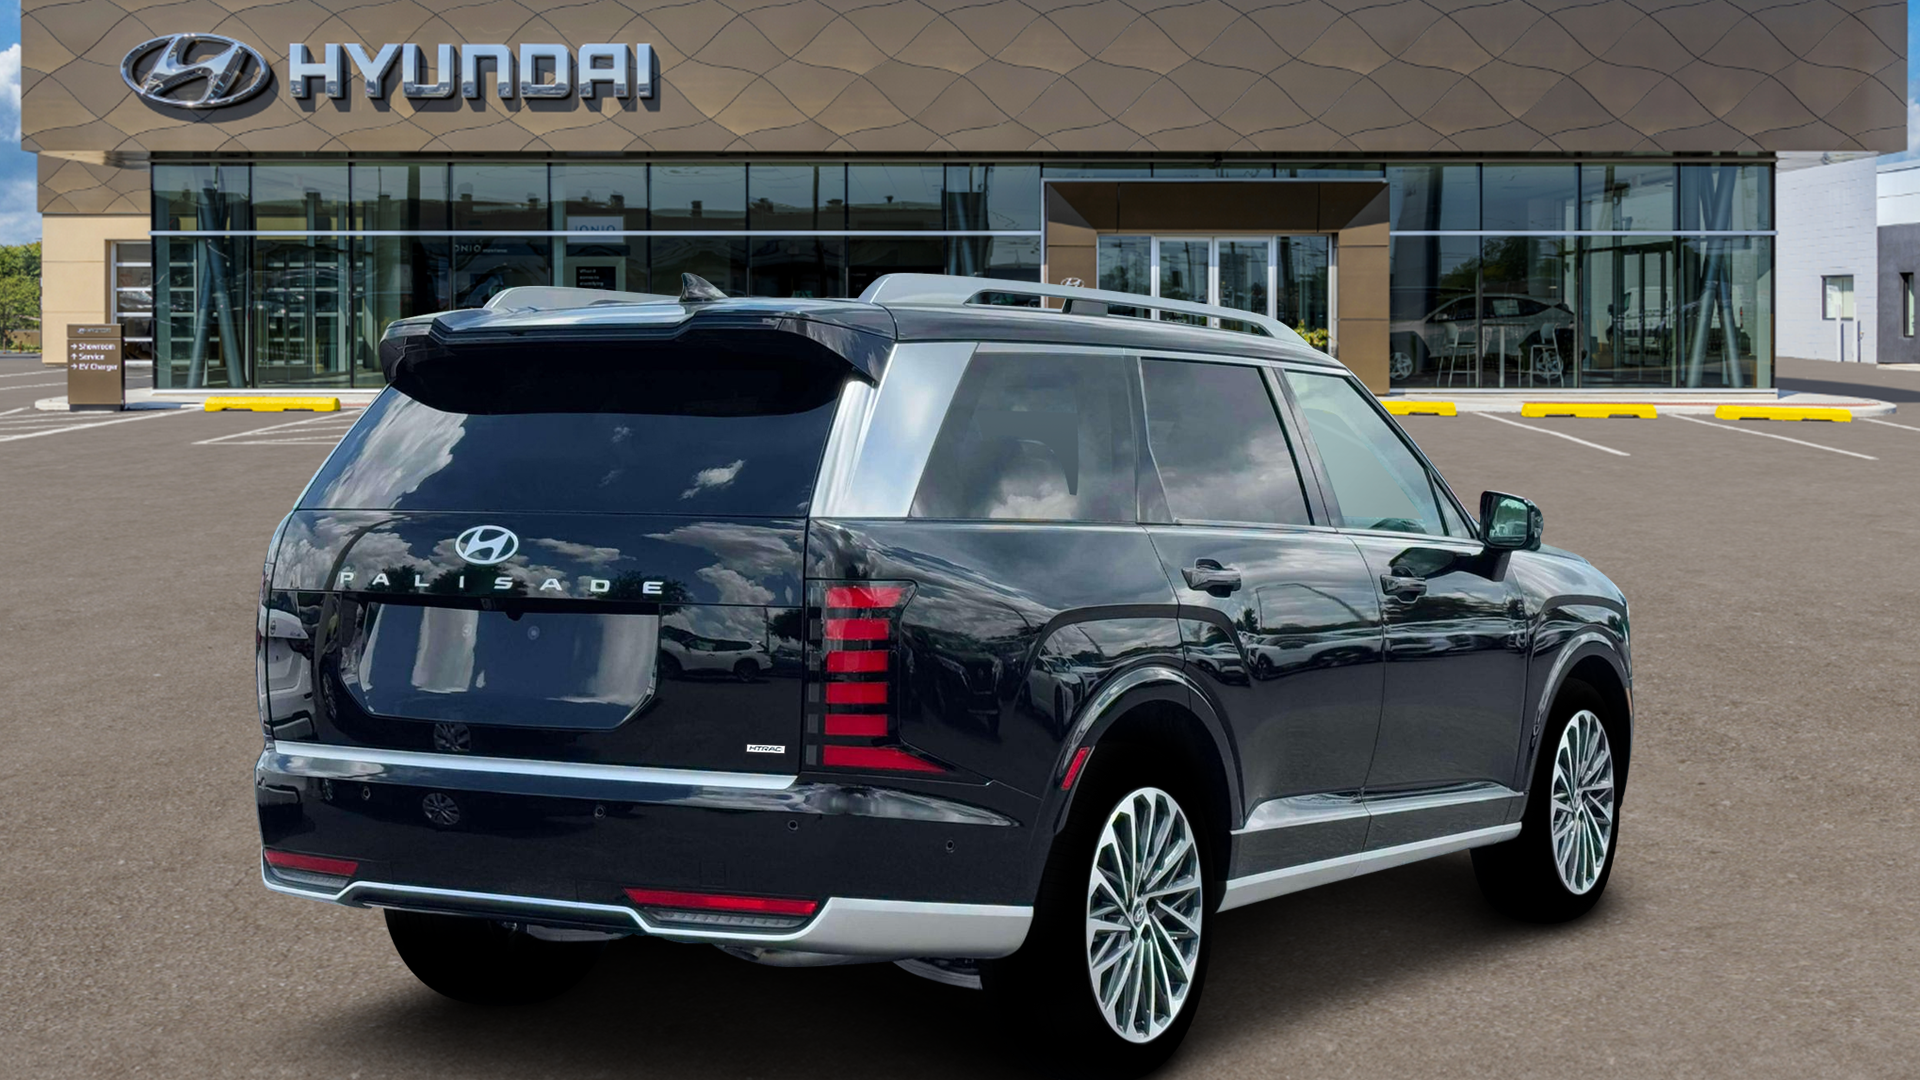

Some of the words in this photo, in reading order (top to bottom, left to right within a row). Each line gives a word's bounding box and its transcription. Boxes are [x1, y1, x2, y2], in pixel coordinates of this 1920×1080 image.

[289, 43, 653, 99] HYUNDAI
[78, 342, 116, 350] Showroom
[78, 352, 105, 361] Service
[78, 362, 90, 371] EV
[90, 362, 118, 372] Charger
[339, 571, 665, 595] PALISADE
